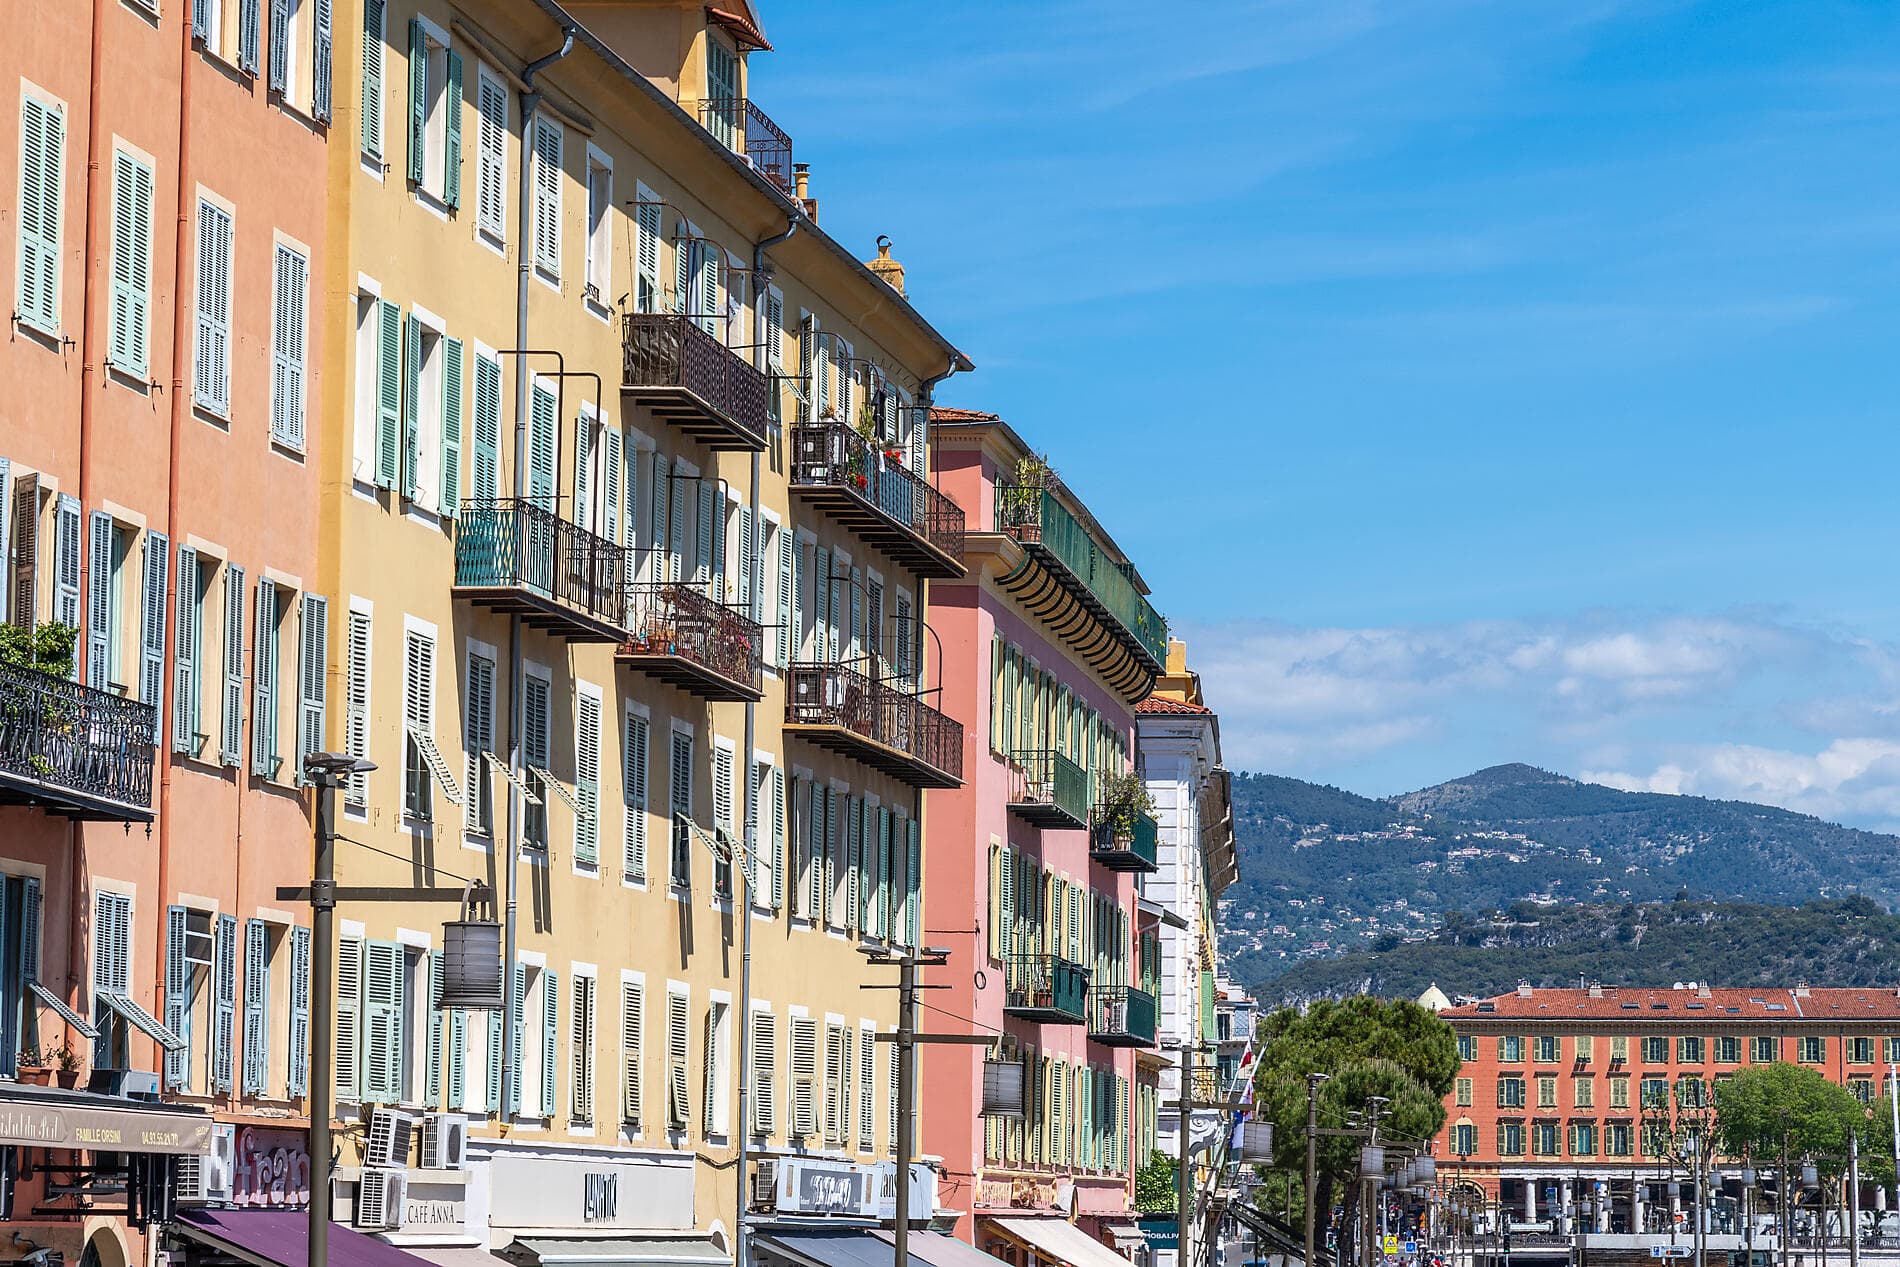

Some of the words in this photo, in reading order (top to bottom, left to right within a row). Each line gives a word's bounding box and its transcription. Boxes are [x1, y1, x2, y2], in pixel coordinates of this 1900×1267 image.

[75, 1127, 101, 1143] FAMILLE
[101, 1129, 122, 1144] ORSINI
[407, 1200, 428, 1224] CAFÉ
[430, 1203, 455, 1224] ANNA
